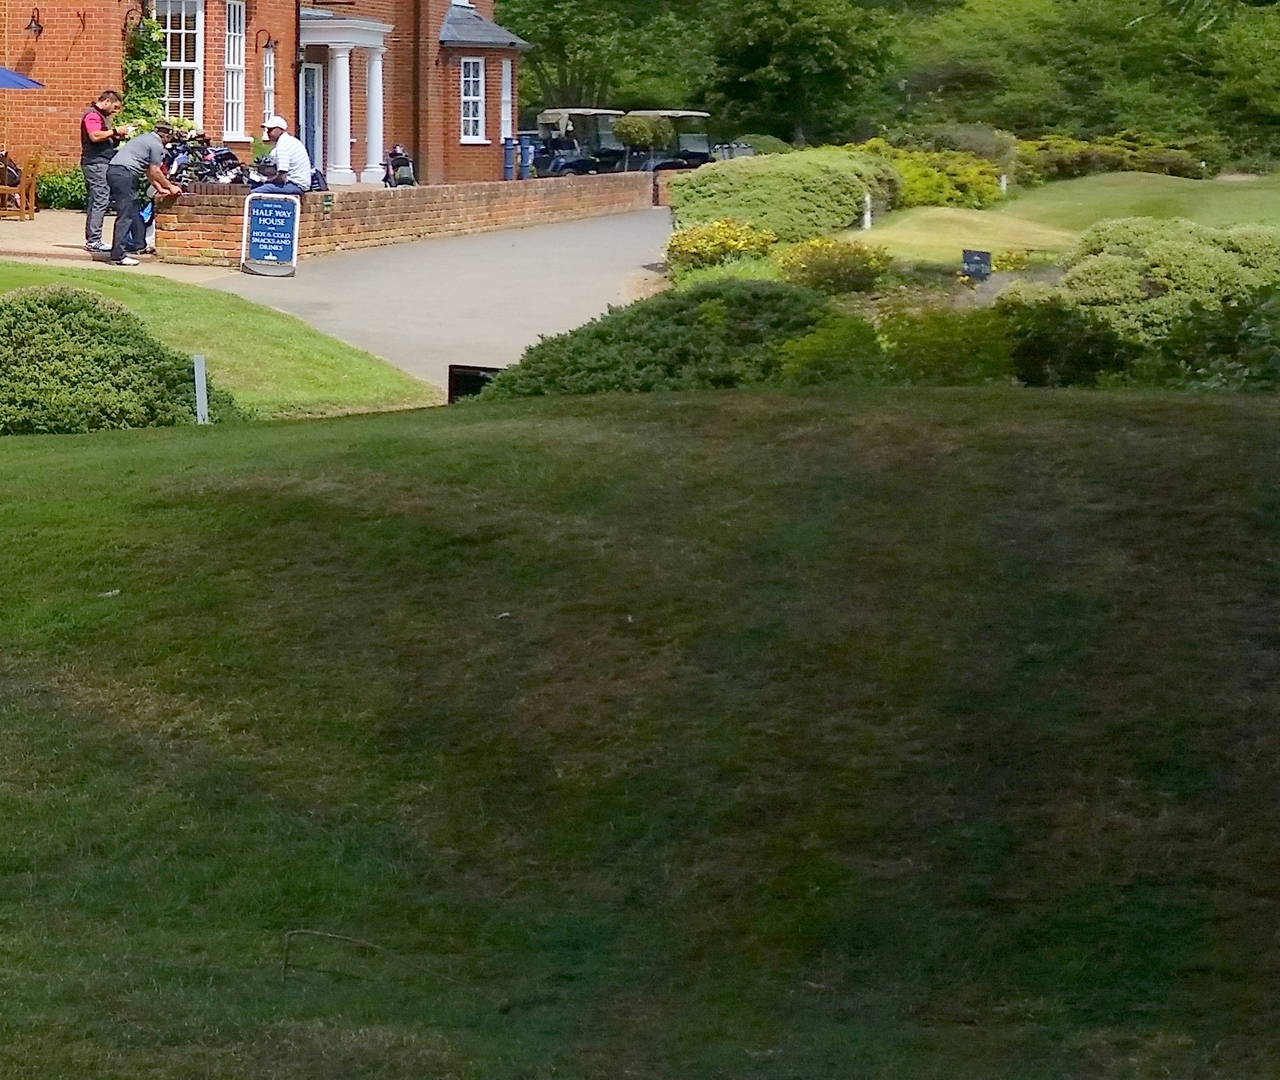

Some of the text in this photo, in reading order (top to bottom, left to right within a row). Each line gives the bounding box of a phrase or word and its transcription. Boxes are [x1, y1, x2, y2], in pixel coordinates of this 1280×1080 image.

[252, 208, 292, 218] HALF WAY
[258, 217, 286, 226] HOUSE
